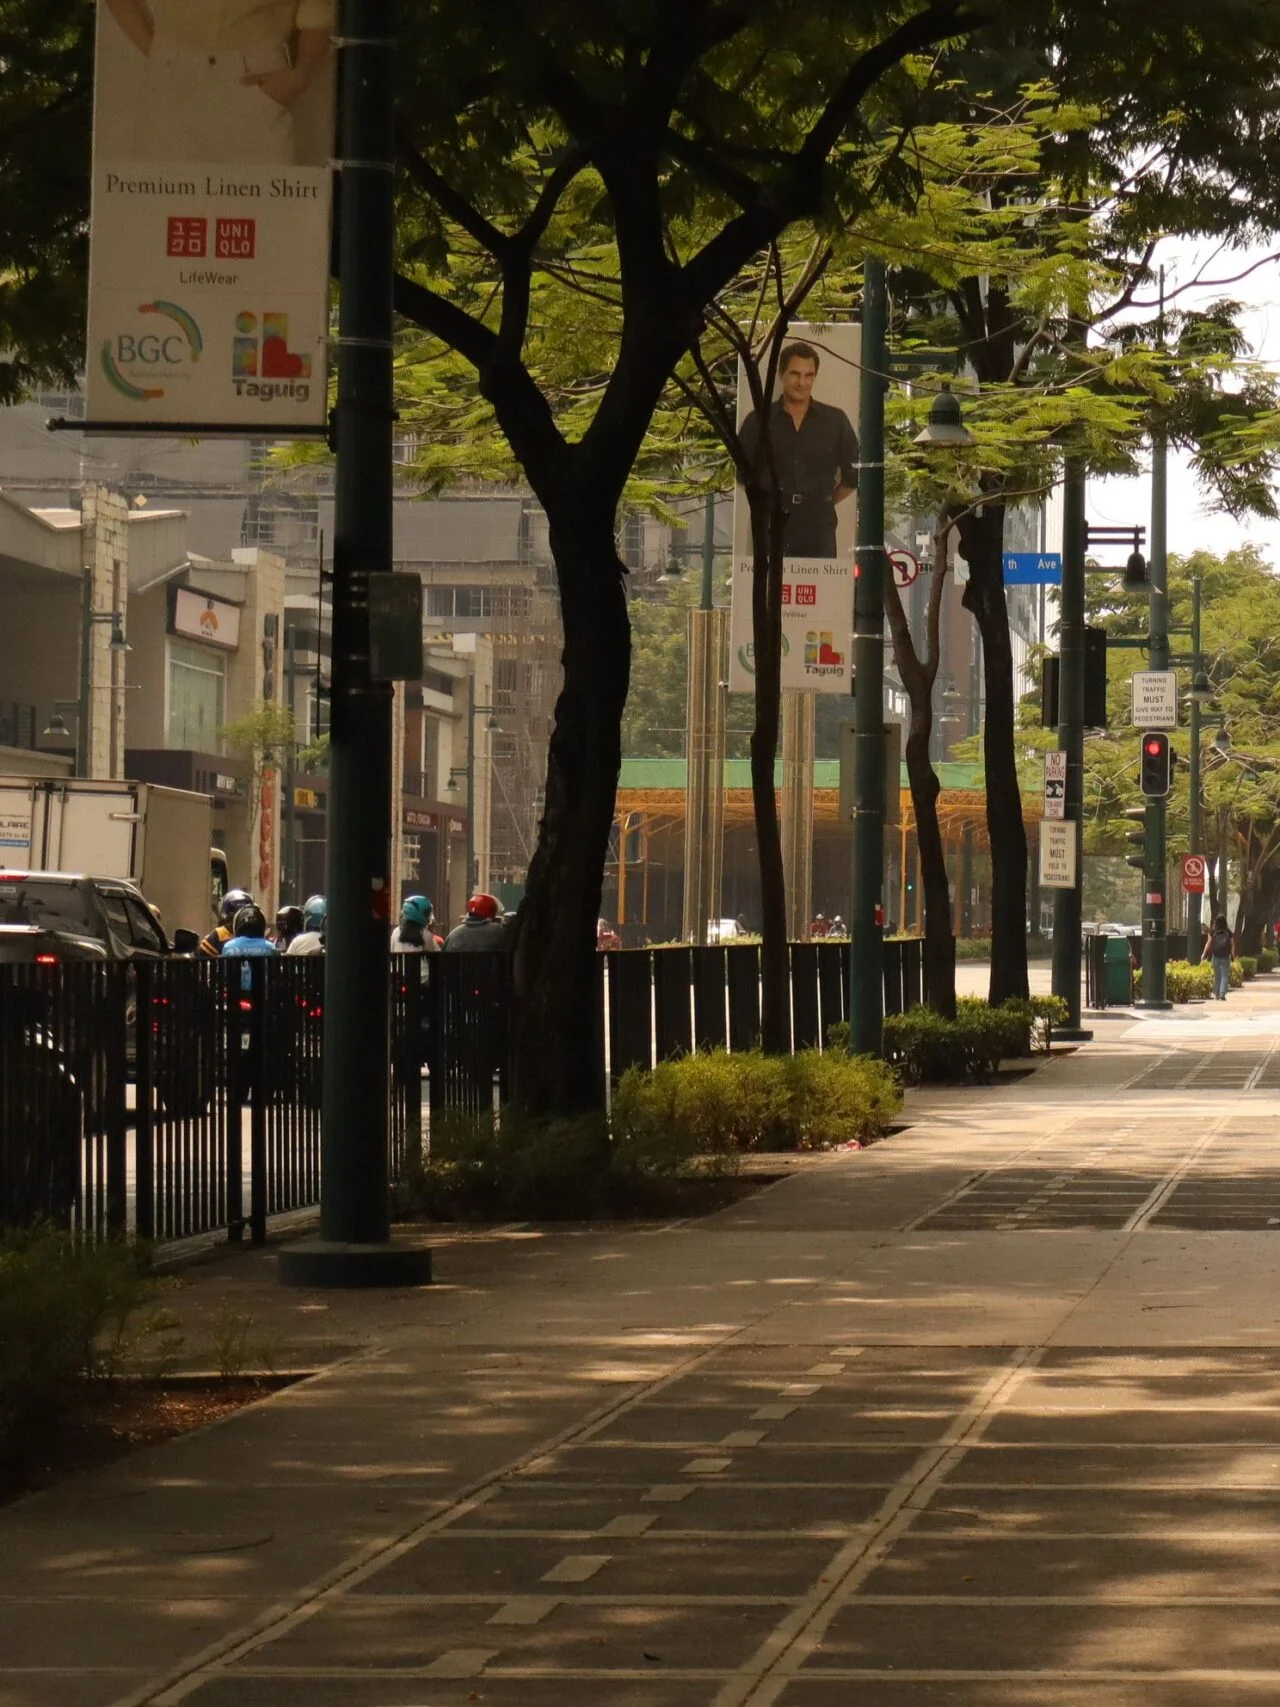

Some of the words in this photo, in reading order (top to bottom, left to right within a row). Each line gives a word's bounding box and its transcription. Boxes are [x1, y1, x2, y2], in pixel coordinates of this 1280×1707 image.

[106, 174, 196, 197] Premium
[206, 177, 261, 198] Linen
[270, 180, 319, 199] Shirt
[179, 271, 239, 285] LifeWear
[117, 334, 183, 364] BGC
[232, 378, 310, 401] Taguig
[790, 564, 819, 575] Linen
[823, 565, 848, 576] Shirt
[1038, 558, 1057, 570] Ave
[804, 665, 844, 677] Taguig
[1050, 754, 1061, 766] NO
[1046, 767, 1064, 778] PARKING
[0, 821, 29, 829] LAIRE
[1050, 849, 1065, 859] MUST
